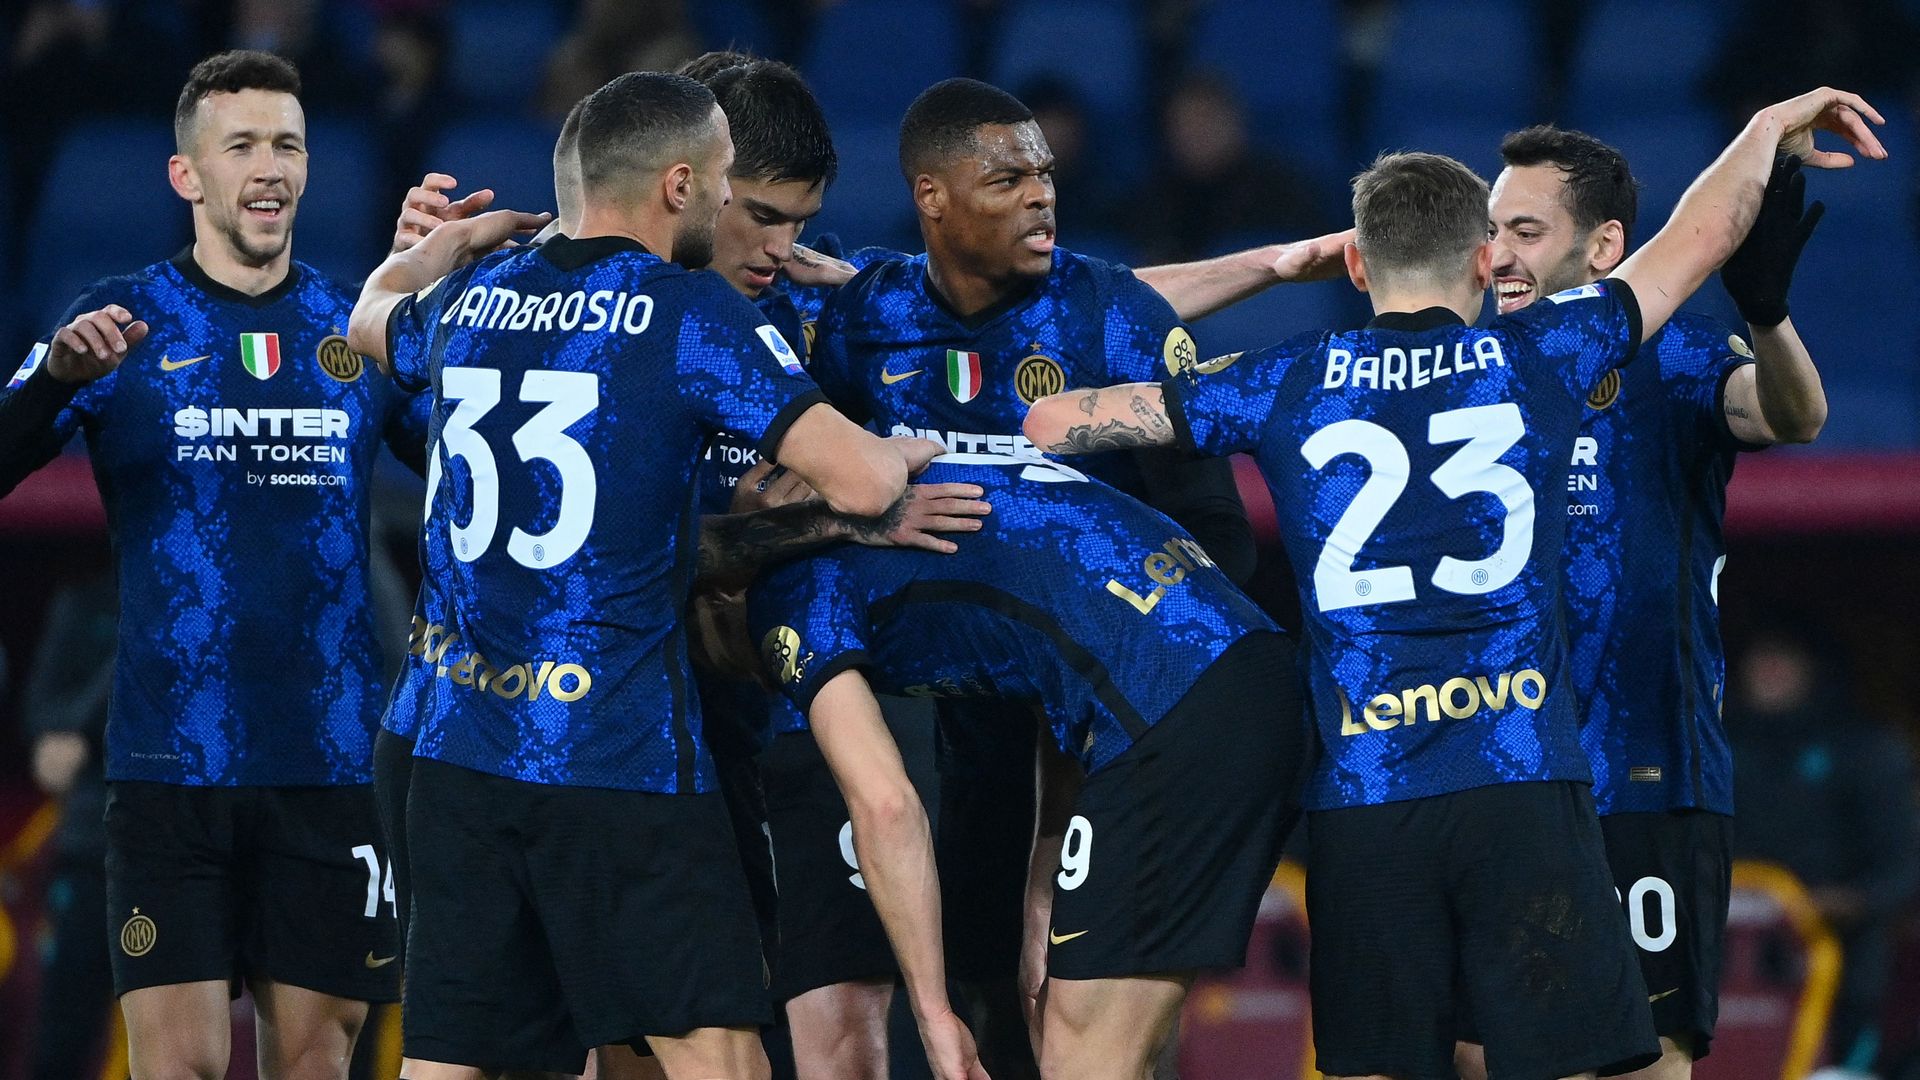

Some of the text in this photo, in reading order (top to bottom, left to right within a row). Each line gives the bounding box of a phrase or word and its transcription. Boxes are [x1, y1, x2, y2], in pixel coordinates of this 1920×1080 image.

[1323, 336, 1505, 391] BARELLA
[174, 405, 350, 440] $INTER
[177, 445, 345, 463] FAN TOKEN
[247, 471, 265, 487] by
[441, 366, 599, 570] 33
[1300, 402, 1535, 612] 23
[1334, 669, 1547, 737] Lenovo
[1057, 815, 1093, 891] 9
[1614, 876, 1677, 953] 0
